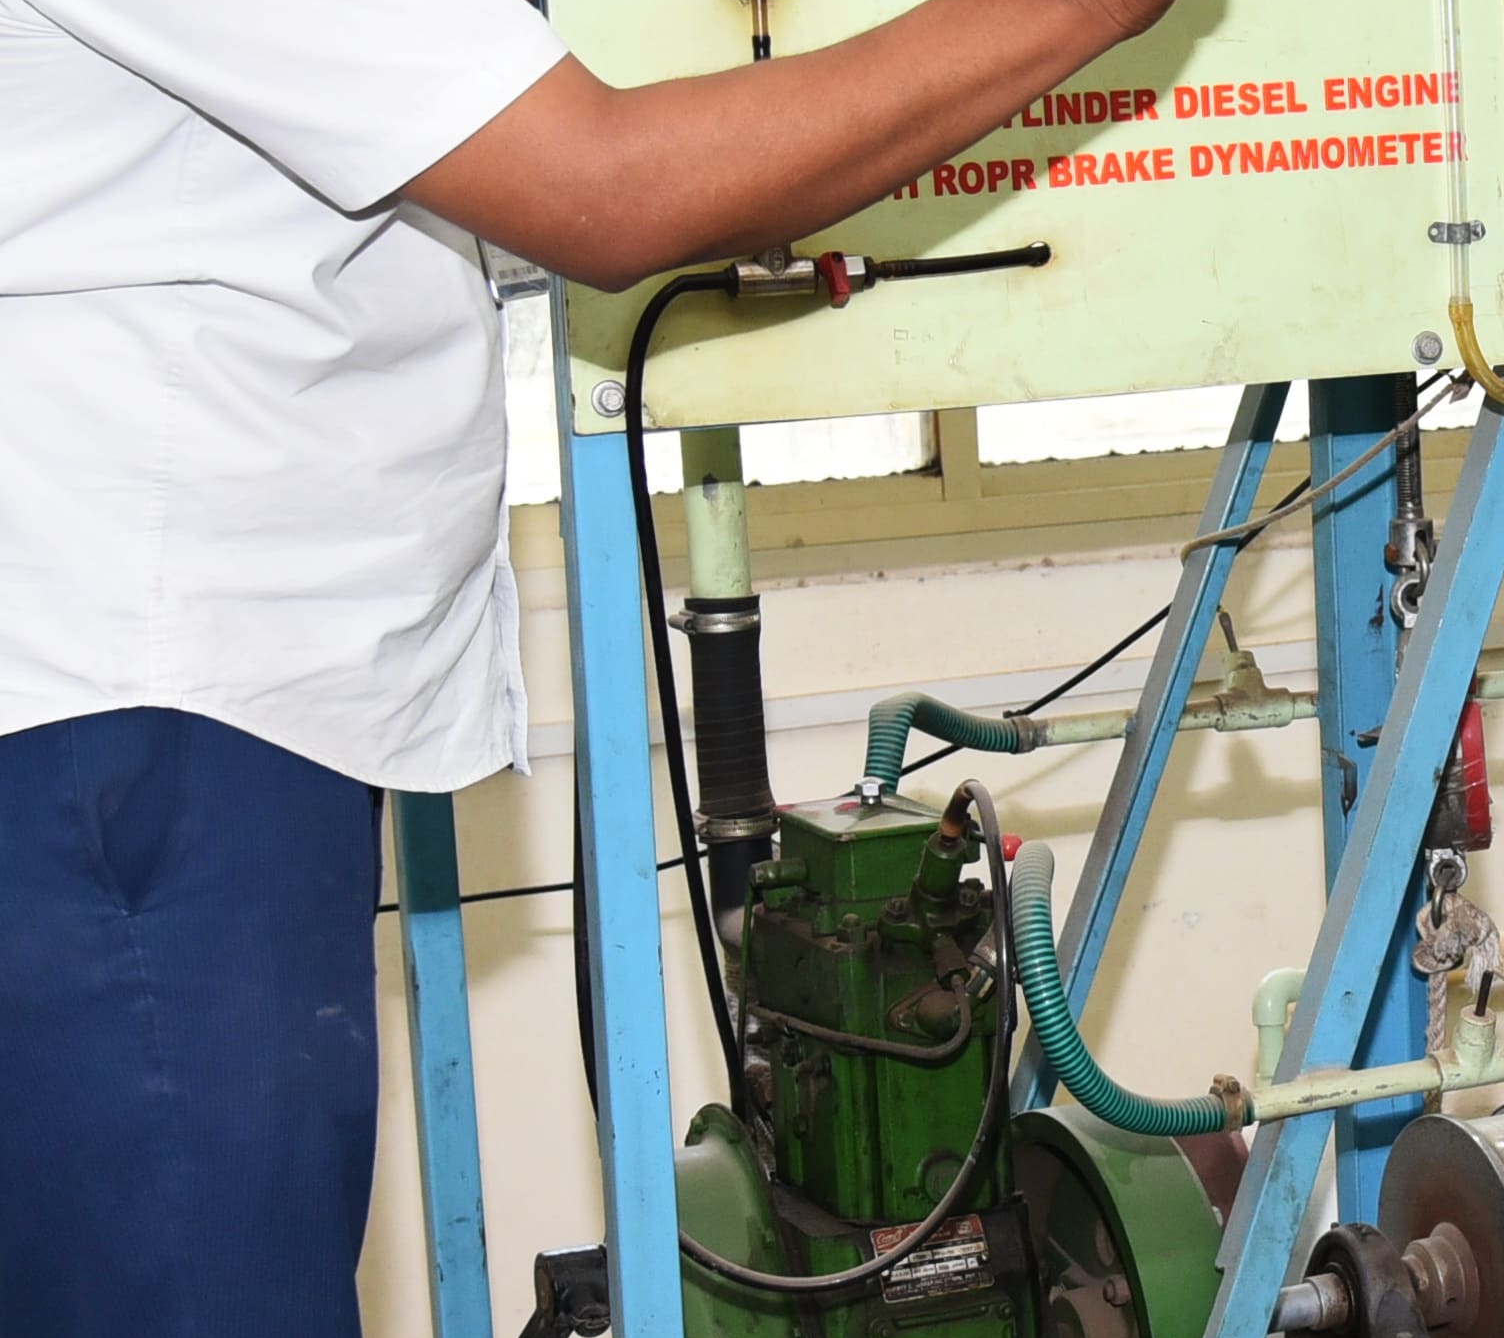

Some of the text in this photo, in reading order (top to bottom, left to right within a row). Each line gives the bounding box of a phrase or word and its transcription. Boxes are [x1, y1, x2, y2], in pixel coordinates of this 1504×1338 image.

[1174, 81, 1307, 120] DIESEL
[1324, 71, 1460, 111] ENGINE
[933, 160, 1036, 197] ROPR
[1049, 148, 1176, 189] BRAKE
[1190, 131, 1469, 178] DYNAMOMETER
